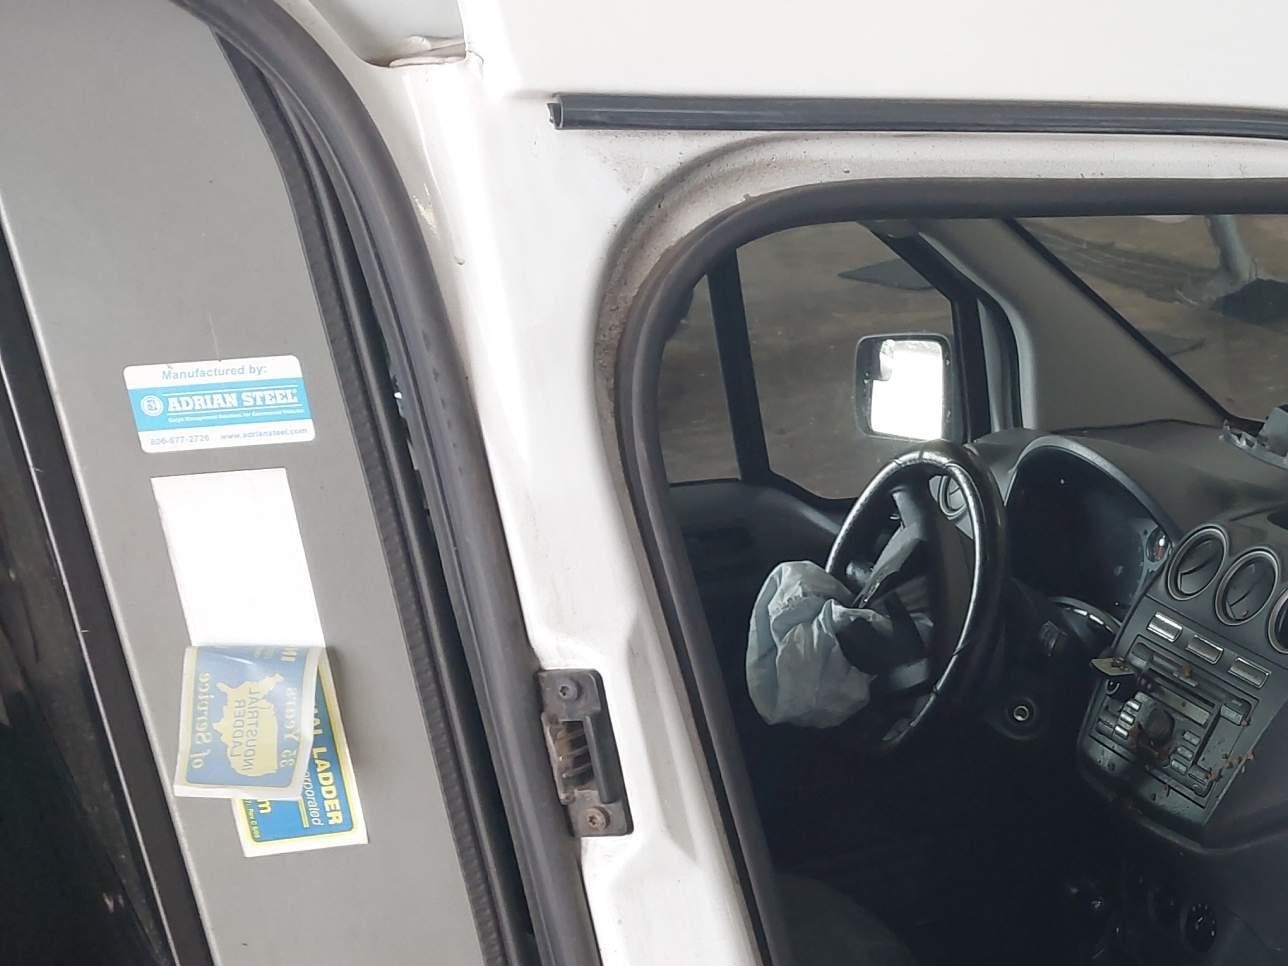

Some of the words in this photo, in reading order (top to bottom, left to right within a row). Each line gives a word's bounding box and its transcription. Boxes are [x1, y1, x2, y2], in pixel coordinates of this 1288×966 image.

[162, 365, 245, 380] Manufactured
[248, 364, 268, 376] by:
[167, 392, 238, 412] ADRIAN
[241, 388, 299, 407] STEEL
[312, 746, 343, 825] LADDER
